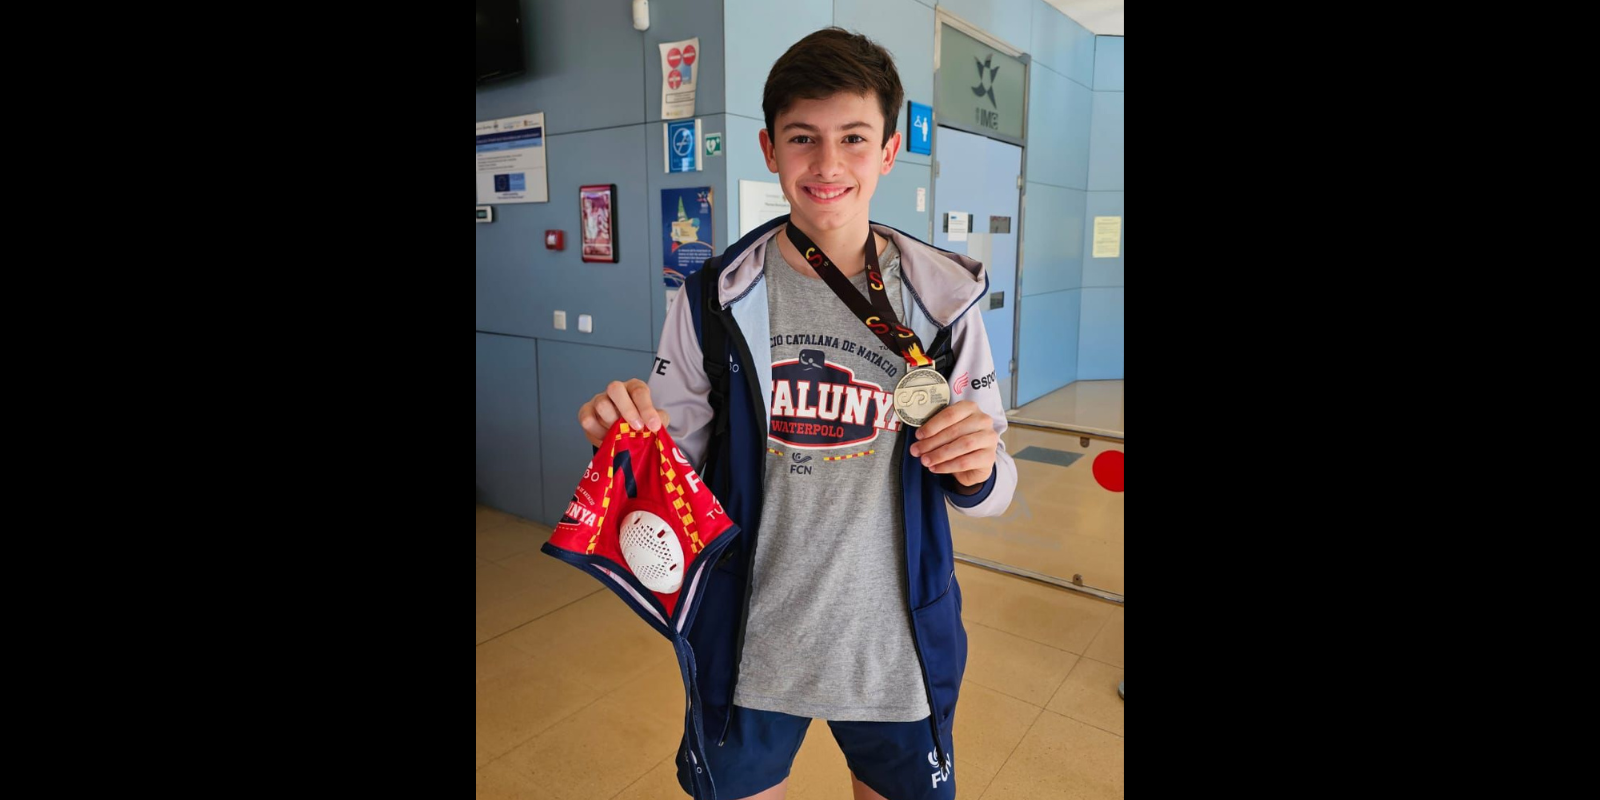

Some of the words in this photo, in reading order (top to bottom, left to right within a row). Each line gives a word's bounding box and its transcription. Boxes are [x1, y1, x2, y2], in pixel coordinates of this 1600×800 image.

[786, 334, 839, 348] CATALANA
[842, 340, 856, 353] DE
[772, 379, 901, 432] ALUNY
[771, 420, 845, 438] WATERPOLO
[790, 465, 812, 475] FCN
